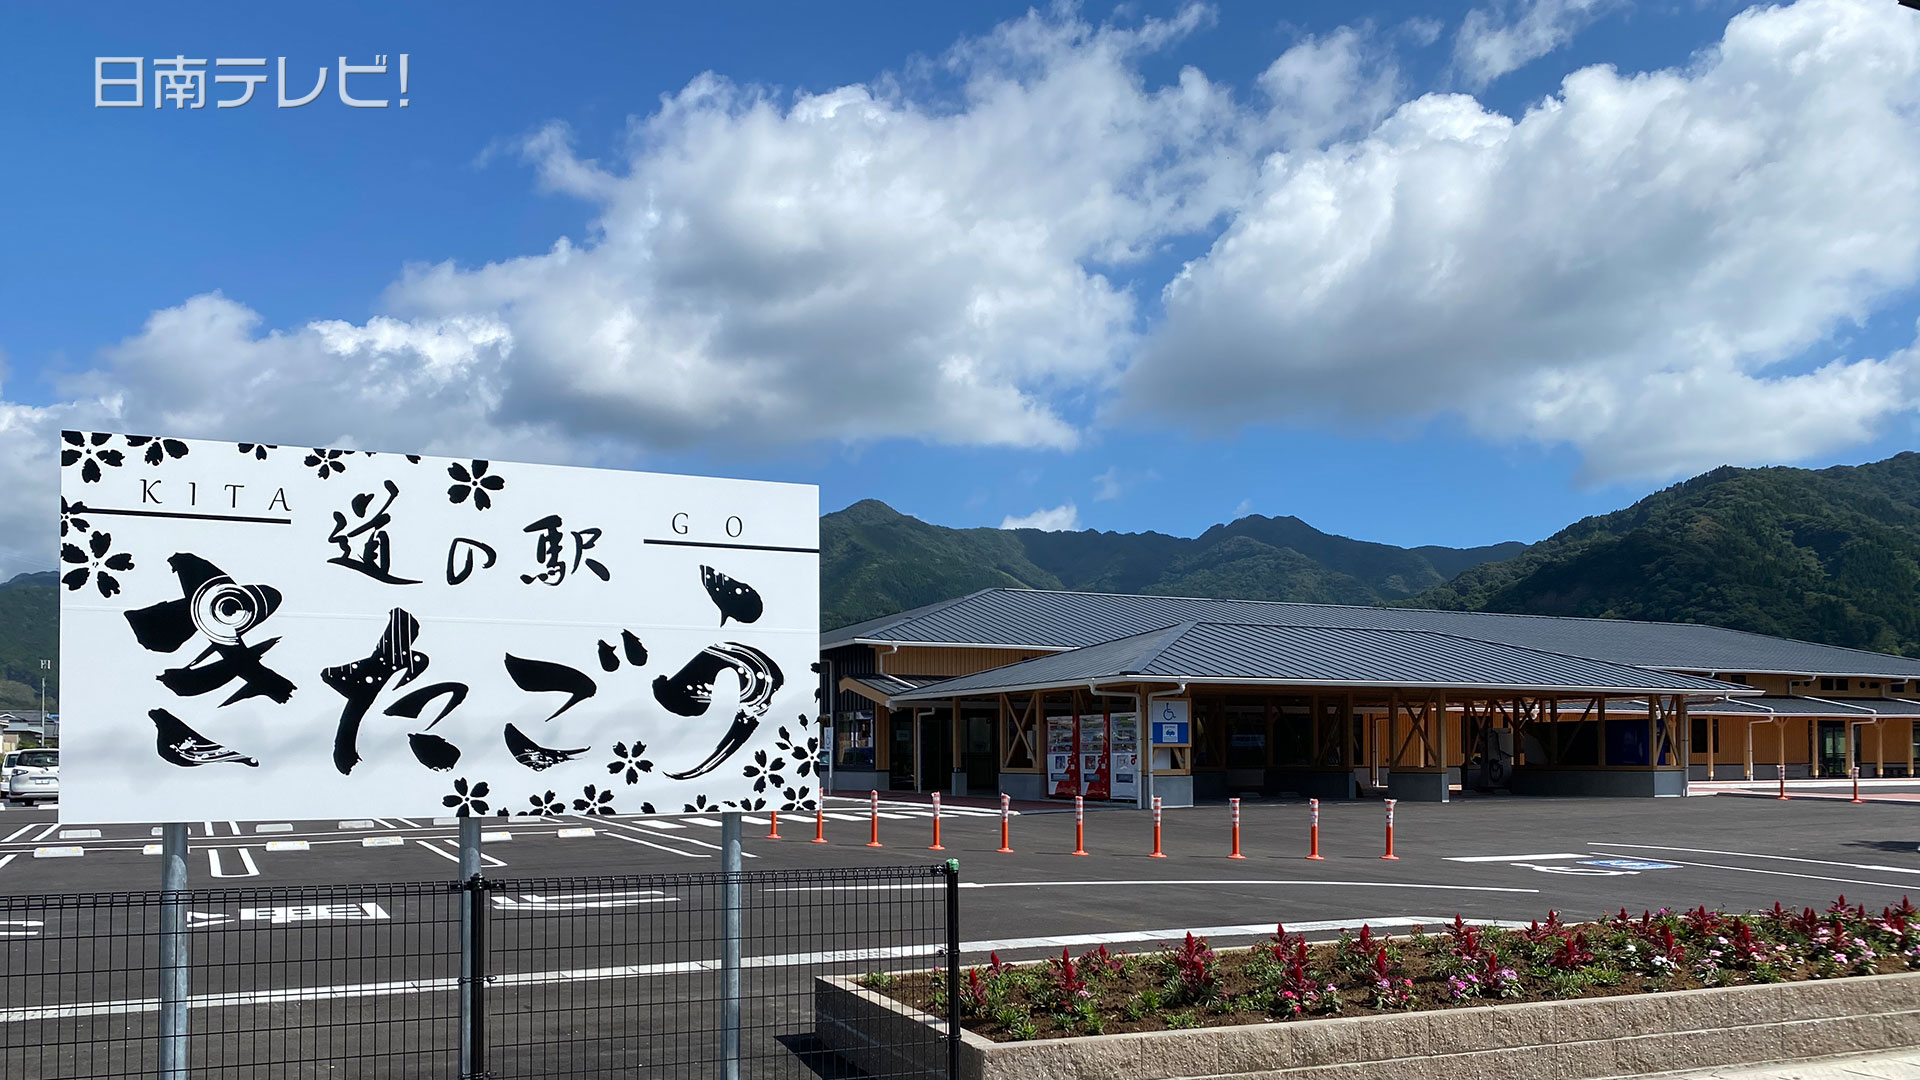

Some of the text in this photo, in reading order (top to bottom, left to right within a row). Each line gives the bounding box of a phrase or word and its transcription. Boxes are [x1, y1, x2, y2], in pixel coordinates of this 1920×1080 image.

[140, 478, 292, 512] KITA
[671, 512, 745, 539] GO
[327, 480, 611, 587] 道の駅
[124, 553, 785, 782] きたごう
